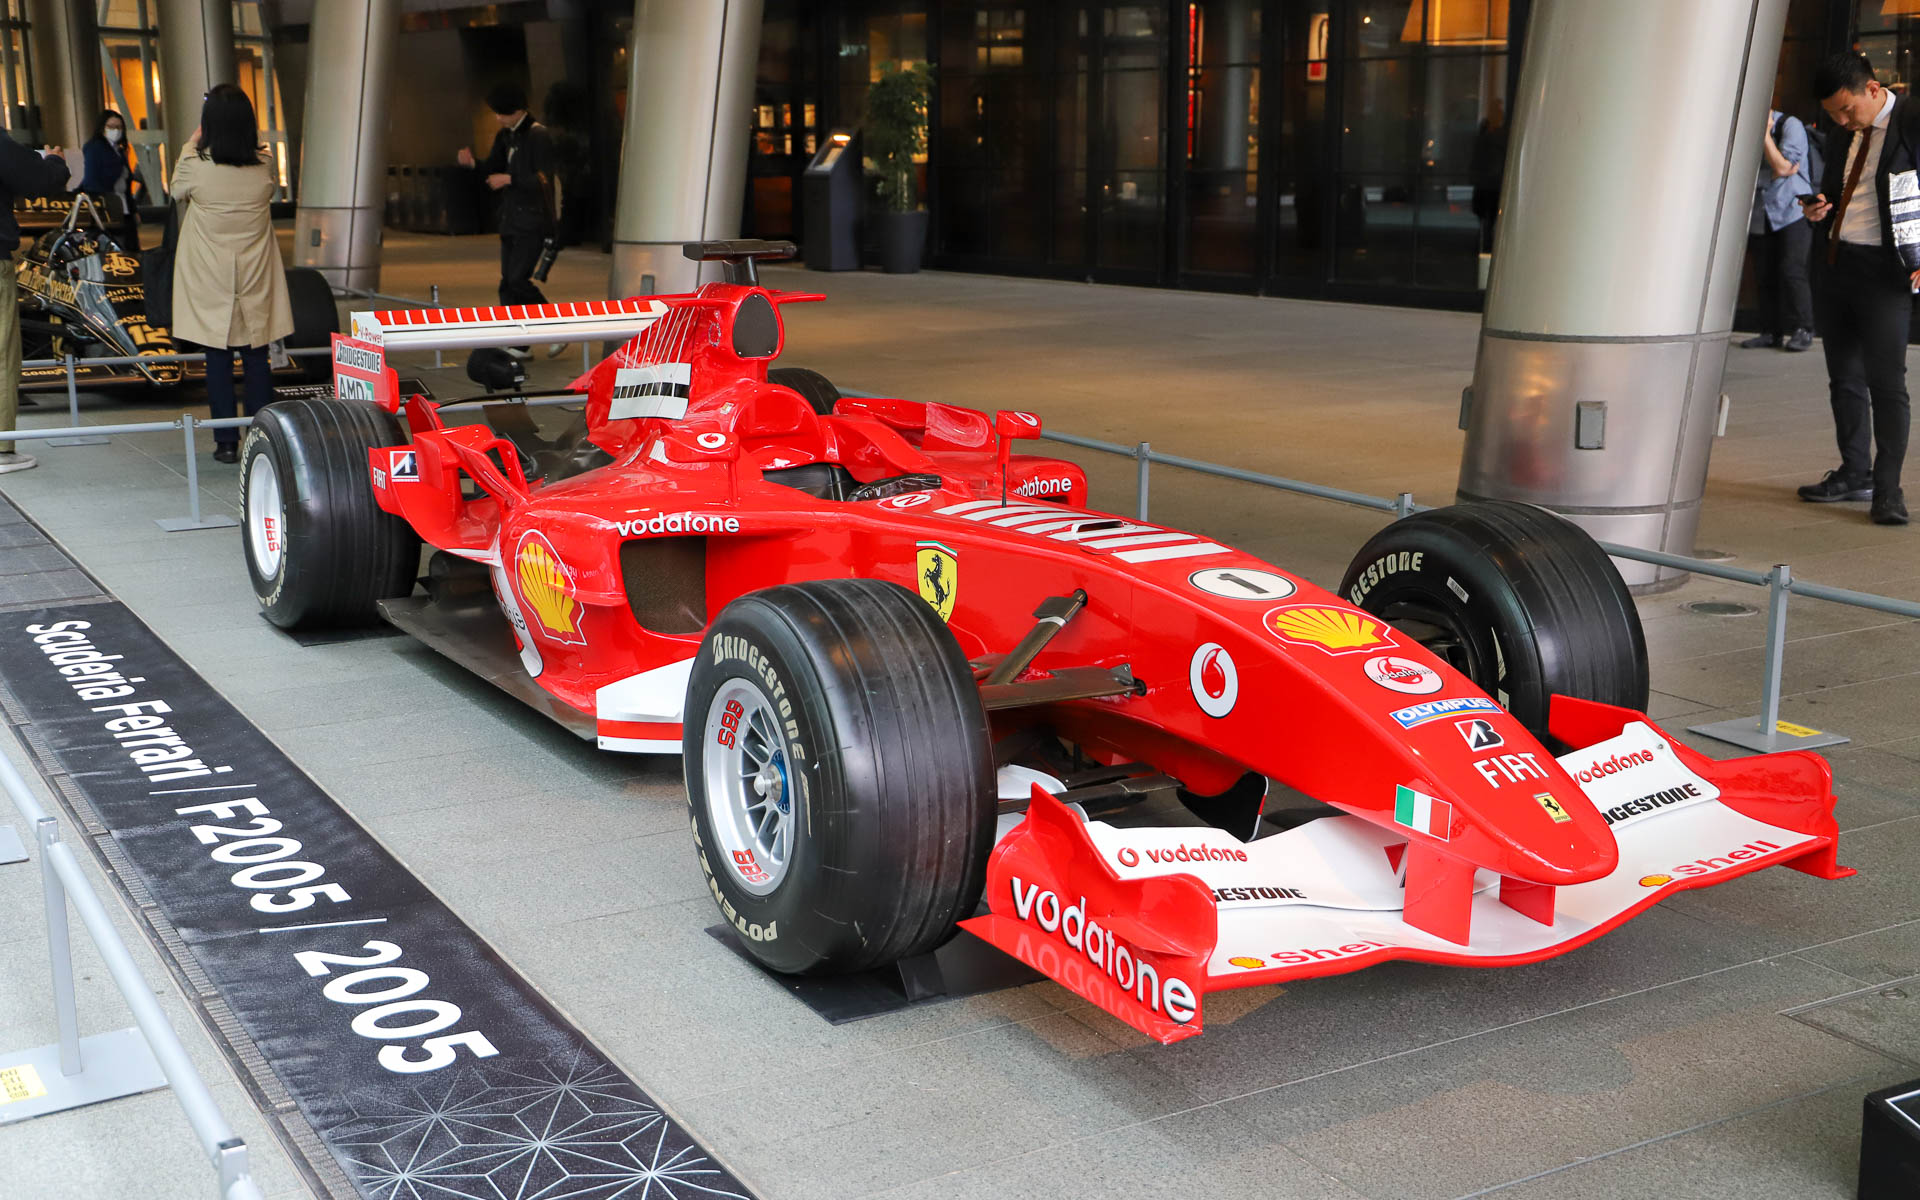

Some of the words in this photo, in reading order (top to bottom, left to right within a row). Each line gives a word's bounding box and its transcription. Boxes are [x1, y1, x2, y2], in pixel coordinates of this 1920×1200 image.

[128, 323, 173, 346] 12
[21, 367, 92, 377] GOODYAR
[336, 341, 382, 373] BRIDGESTONE
[339, 376, 365, 400] AMD
[373, 467, 387, 490] FIAT
[263, 517, 281, 552] BBS
[616, 511, 741, 538] vodafone
[1216, 573, 1271, 594] 1
[713, 633, 805, 760] BRIDGESTONE
[1396, 698, 1493, 721] OLYMPUS
[718, 699, 744, 750] BBS
[1472, 752, 1550, 789] FIAT
[26, 620, 146, 701] Scuderia
[91, 699, 234, 783] Ferrari
[175, 797, 352, 913] F2005
[294, 940, 500, 1073] 2005
[1146, 843, 1248, 864] vodafone
[1672, 840, 1781, 875] Shell
[691, 815, 778, 942] POTENZA
[732, 848, 770, 883] BBS
[1010, 877, 1196, 1024] vodafone
